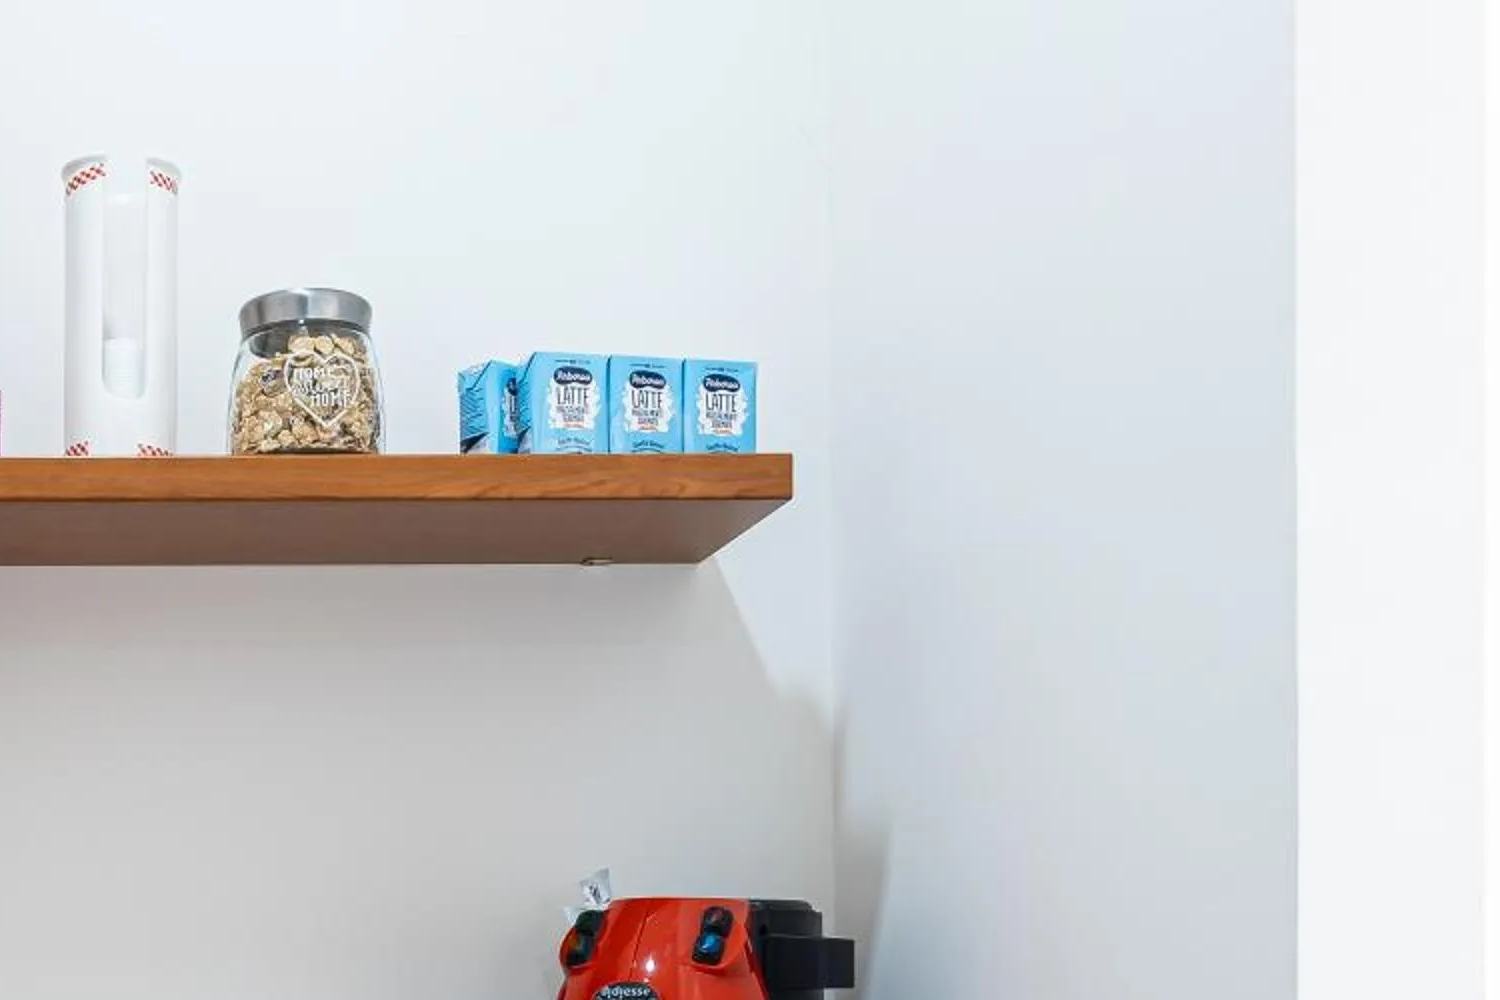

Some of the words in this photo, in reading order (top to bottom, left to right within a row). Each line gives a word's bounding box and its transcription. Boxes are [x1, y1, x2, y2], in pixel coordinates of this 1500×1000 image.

[556, 386, 590, 405] LATTE
[631, 389, 663, 409] LATTE
[705, 393, 738, 413] LATTE
